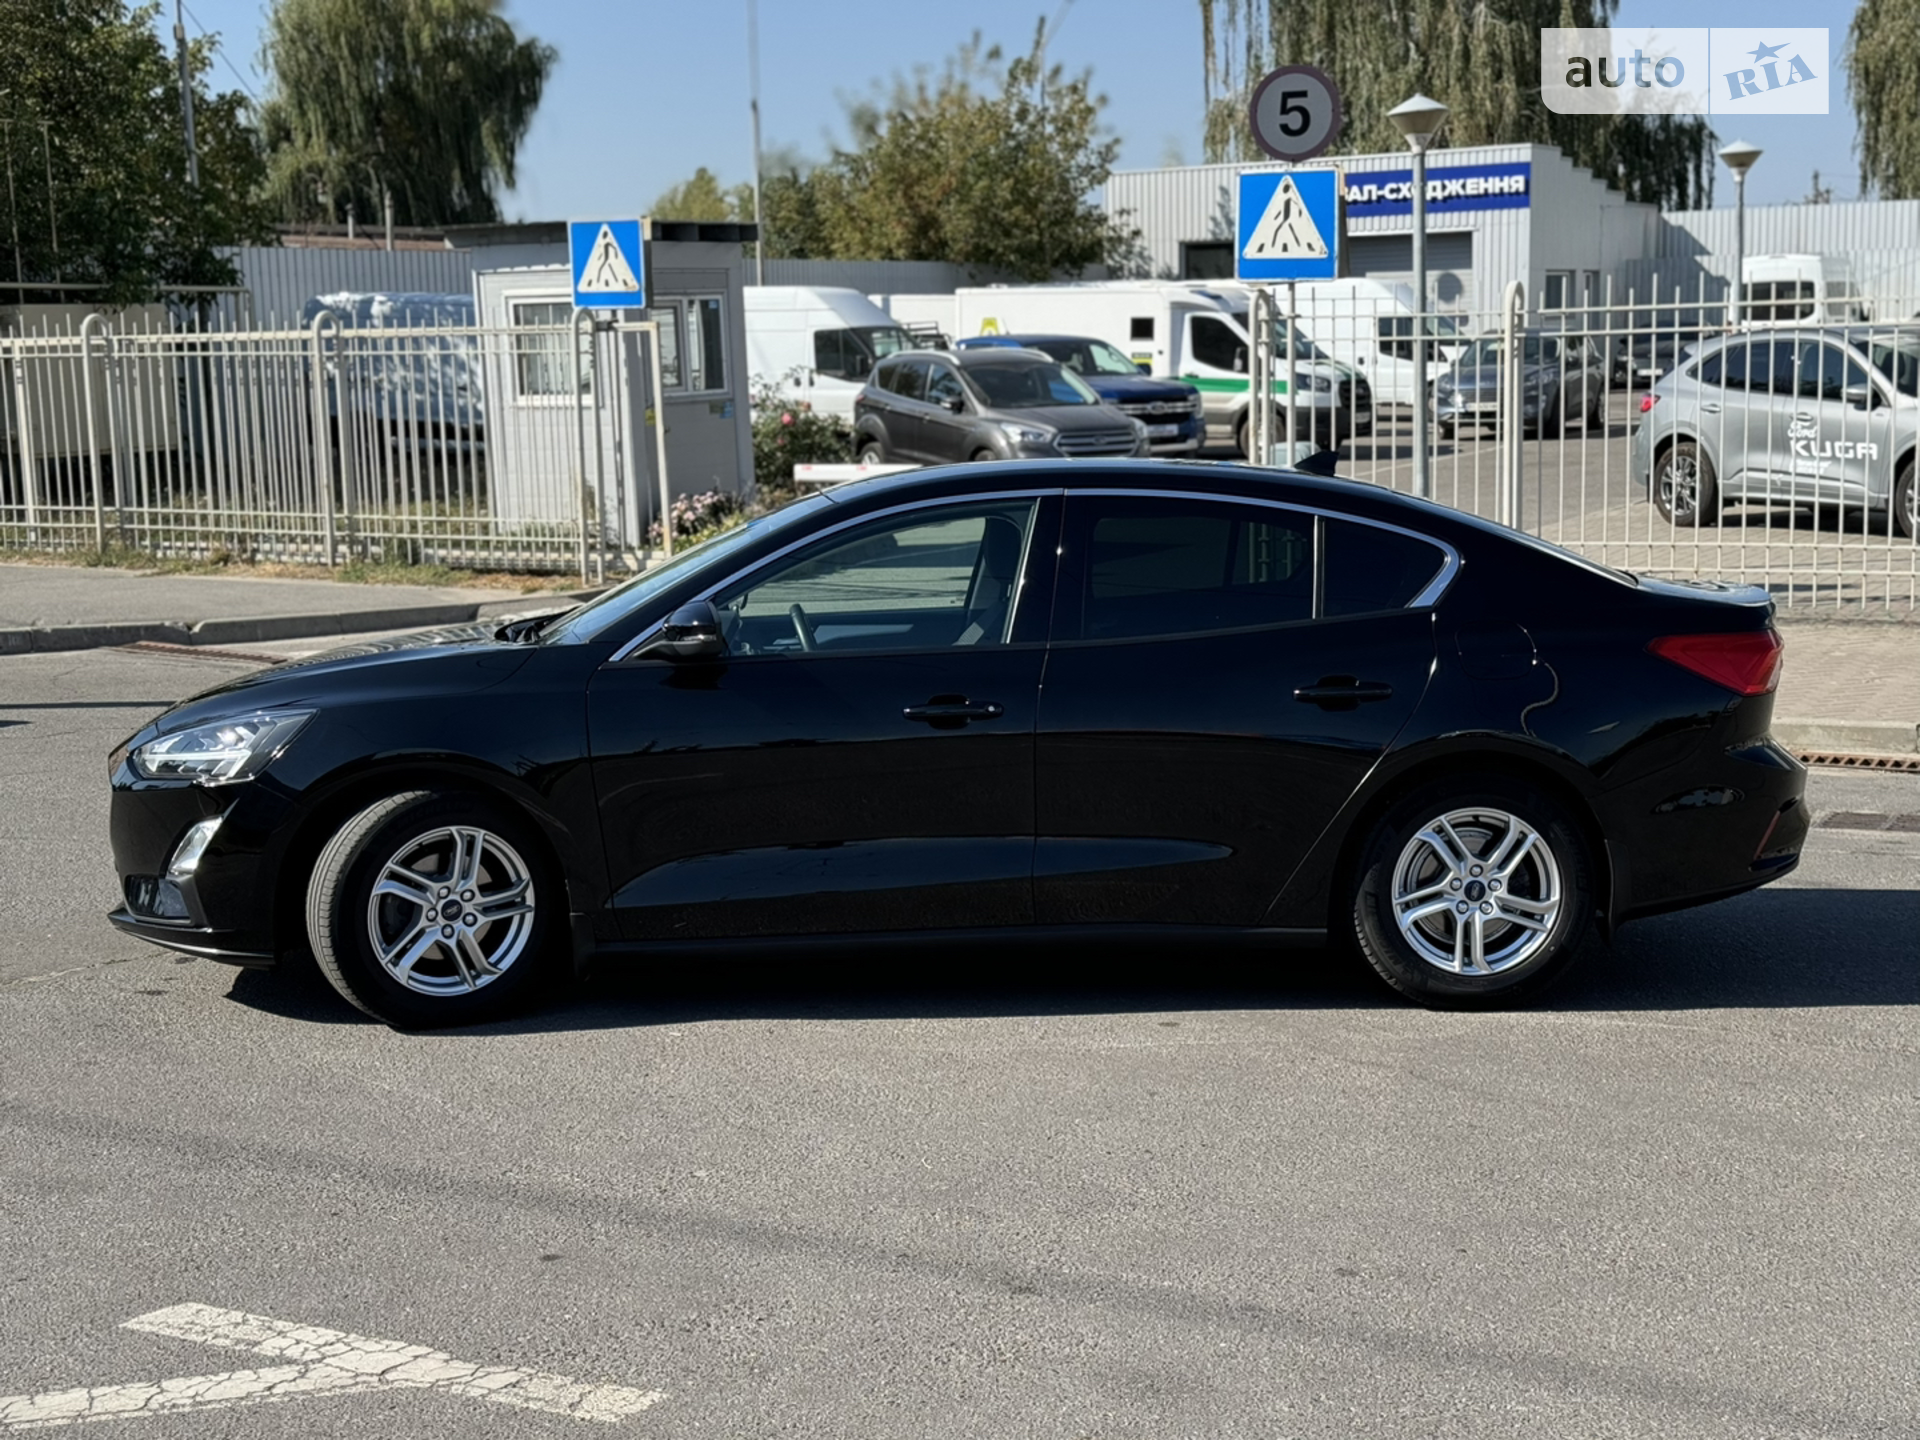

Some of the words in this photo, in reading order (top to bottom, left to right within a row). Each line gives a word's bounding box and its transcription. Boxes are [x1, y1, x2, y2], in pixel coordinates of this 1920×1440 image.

[1278, 90, 1312, 138] 5
[1344, 175, 1525, 202] АЛ-СХДЖЕННЯ
[1789, 439, 1878, 461] KUGA
